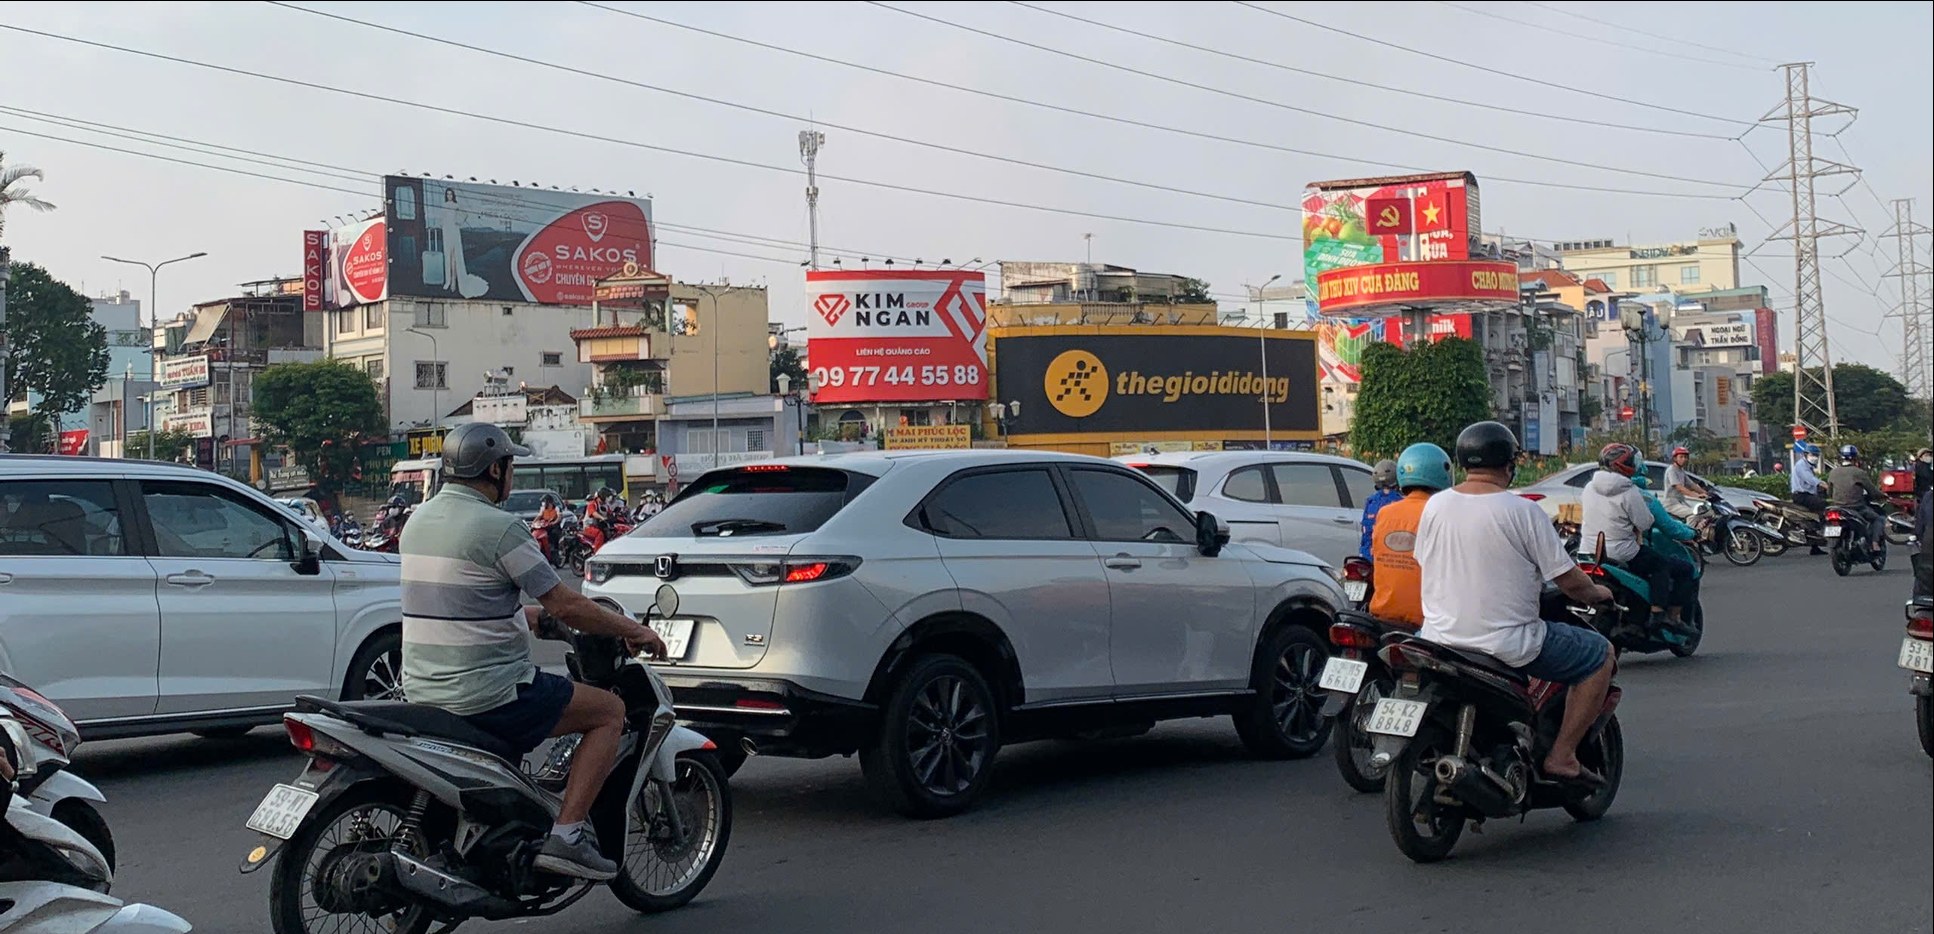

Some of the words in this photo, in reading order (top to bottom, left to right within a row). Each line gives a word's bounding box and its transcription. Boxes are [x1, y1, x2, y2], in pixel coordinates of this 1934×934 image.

[352, 250, 382, 266] SAKOS
[555, 244, 637, 263] SAKOS
[306, 233, 320, 306] SAKOS
[1343, 276, 1359, 297] XIV
[1384, 267, 1420, 292] ĐẢNG
[855, 293, 904, 309] KIM
[855, 311, 930, 327] NGAN
[856, 348, 874, 357] LIÊN
[874, 348, 885, 357] HỆ
[885, 347, 913, 357] QUẢNG
[913, 347, 931, 356] CÁO
[814, 366, 845, 388] 09
[849, 366, 880, 387] 77
[884, 366, 916, 386] 44
[921, 365, 949, 386] 55
[953, 365, 980, 386] 88
[1116, 371, 1290, 403] thegioididong
[917, 426, 945, 436] PHÚC
[947, 426, 967, 437] LỘC
[409, 437, 421, 455] XE
[1381, 700, 1419, 718] 54-K2
[1375, 715, 1413, 733] 8848
